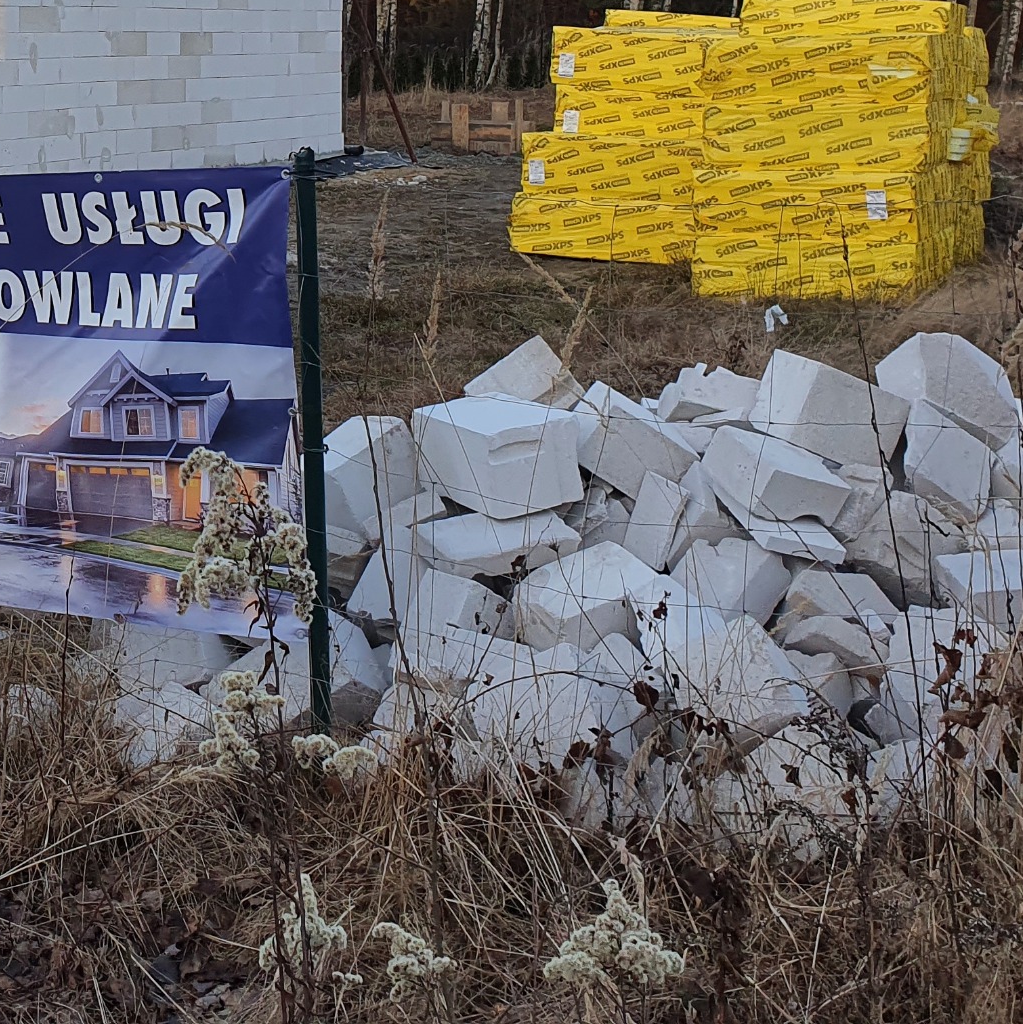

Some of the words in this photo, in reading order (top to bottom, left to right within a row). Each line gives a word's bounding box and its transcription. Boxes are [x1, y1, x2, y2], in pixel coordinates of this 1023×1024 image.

[812, 0, 836, 9] XPS
[837, 11, 860, 22] XPS
[827, 40, 853, 53] XPS
[648, 50, 668, 61] XPS
[599, 61, 619, 71] XPS
[766, 57, 790, 72] XPS
[623, 74, 643, 85] XPS
[734, 83, 756, 95] XPS
[821, 85, 845, 98] XPS
[633, 108, 653, 119] XPS
[858, 110, 884, 122] XPS
[799, 124, 821, 138] XPS
[743, 140, 765, 152] XPS
[826, 142, 850, 155] XPS
[616, 156, 637, 167] XPS
[567, 166, 587, 177] XPS
[643, 170, 663, 182] XPS
[591, 181, 611, 191] XPS
[749, 179, 772, 191] XPS
[841, 183, 867, 193] XPS
[41, 188, 245, 246] USŁUGI
[581, 213, 601, 224] XPS
[530, 223, 551, 232] XPS
[654, 221, 674, 231] XPS
[552, 241, 573, 251] XPS
[716, 244, 738, 258] XPS
[630, 248, 650, 258] XPS
[802, 249, 826, 262] XPS
